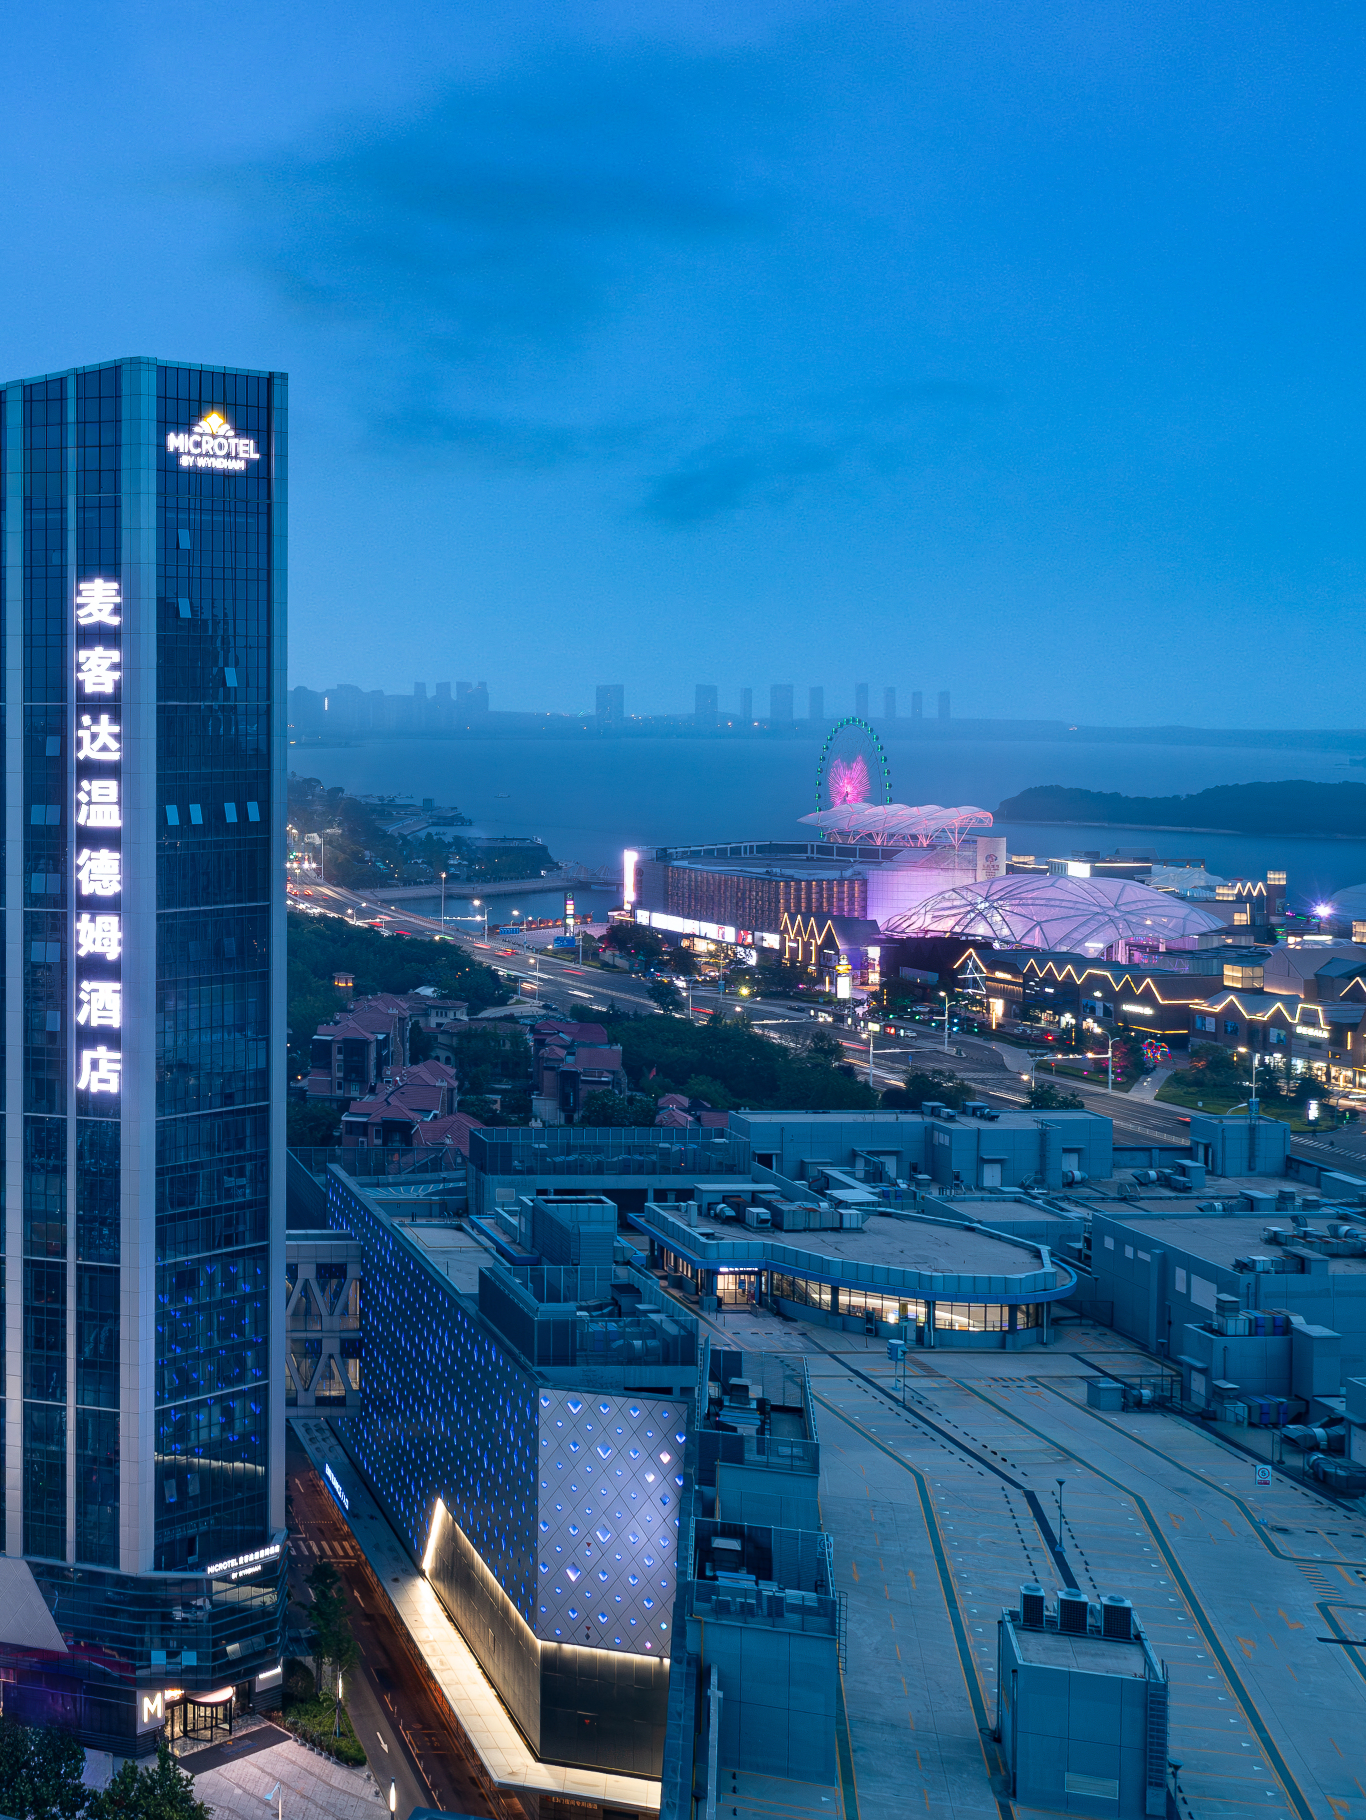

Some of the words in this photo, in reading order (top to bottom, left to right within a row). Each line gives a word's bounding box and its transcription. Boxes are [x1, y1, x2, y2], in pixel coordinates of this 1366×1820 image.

[167, 433, 260, 459] MICROTEL
[179, 455, 194, 467] BY
[196, 457, 245, 471] WYNDHAM
[77, 578, 122, 1093] 麦客达温德姆酒店
[143, 1692, 162, 1723] M
